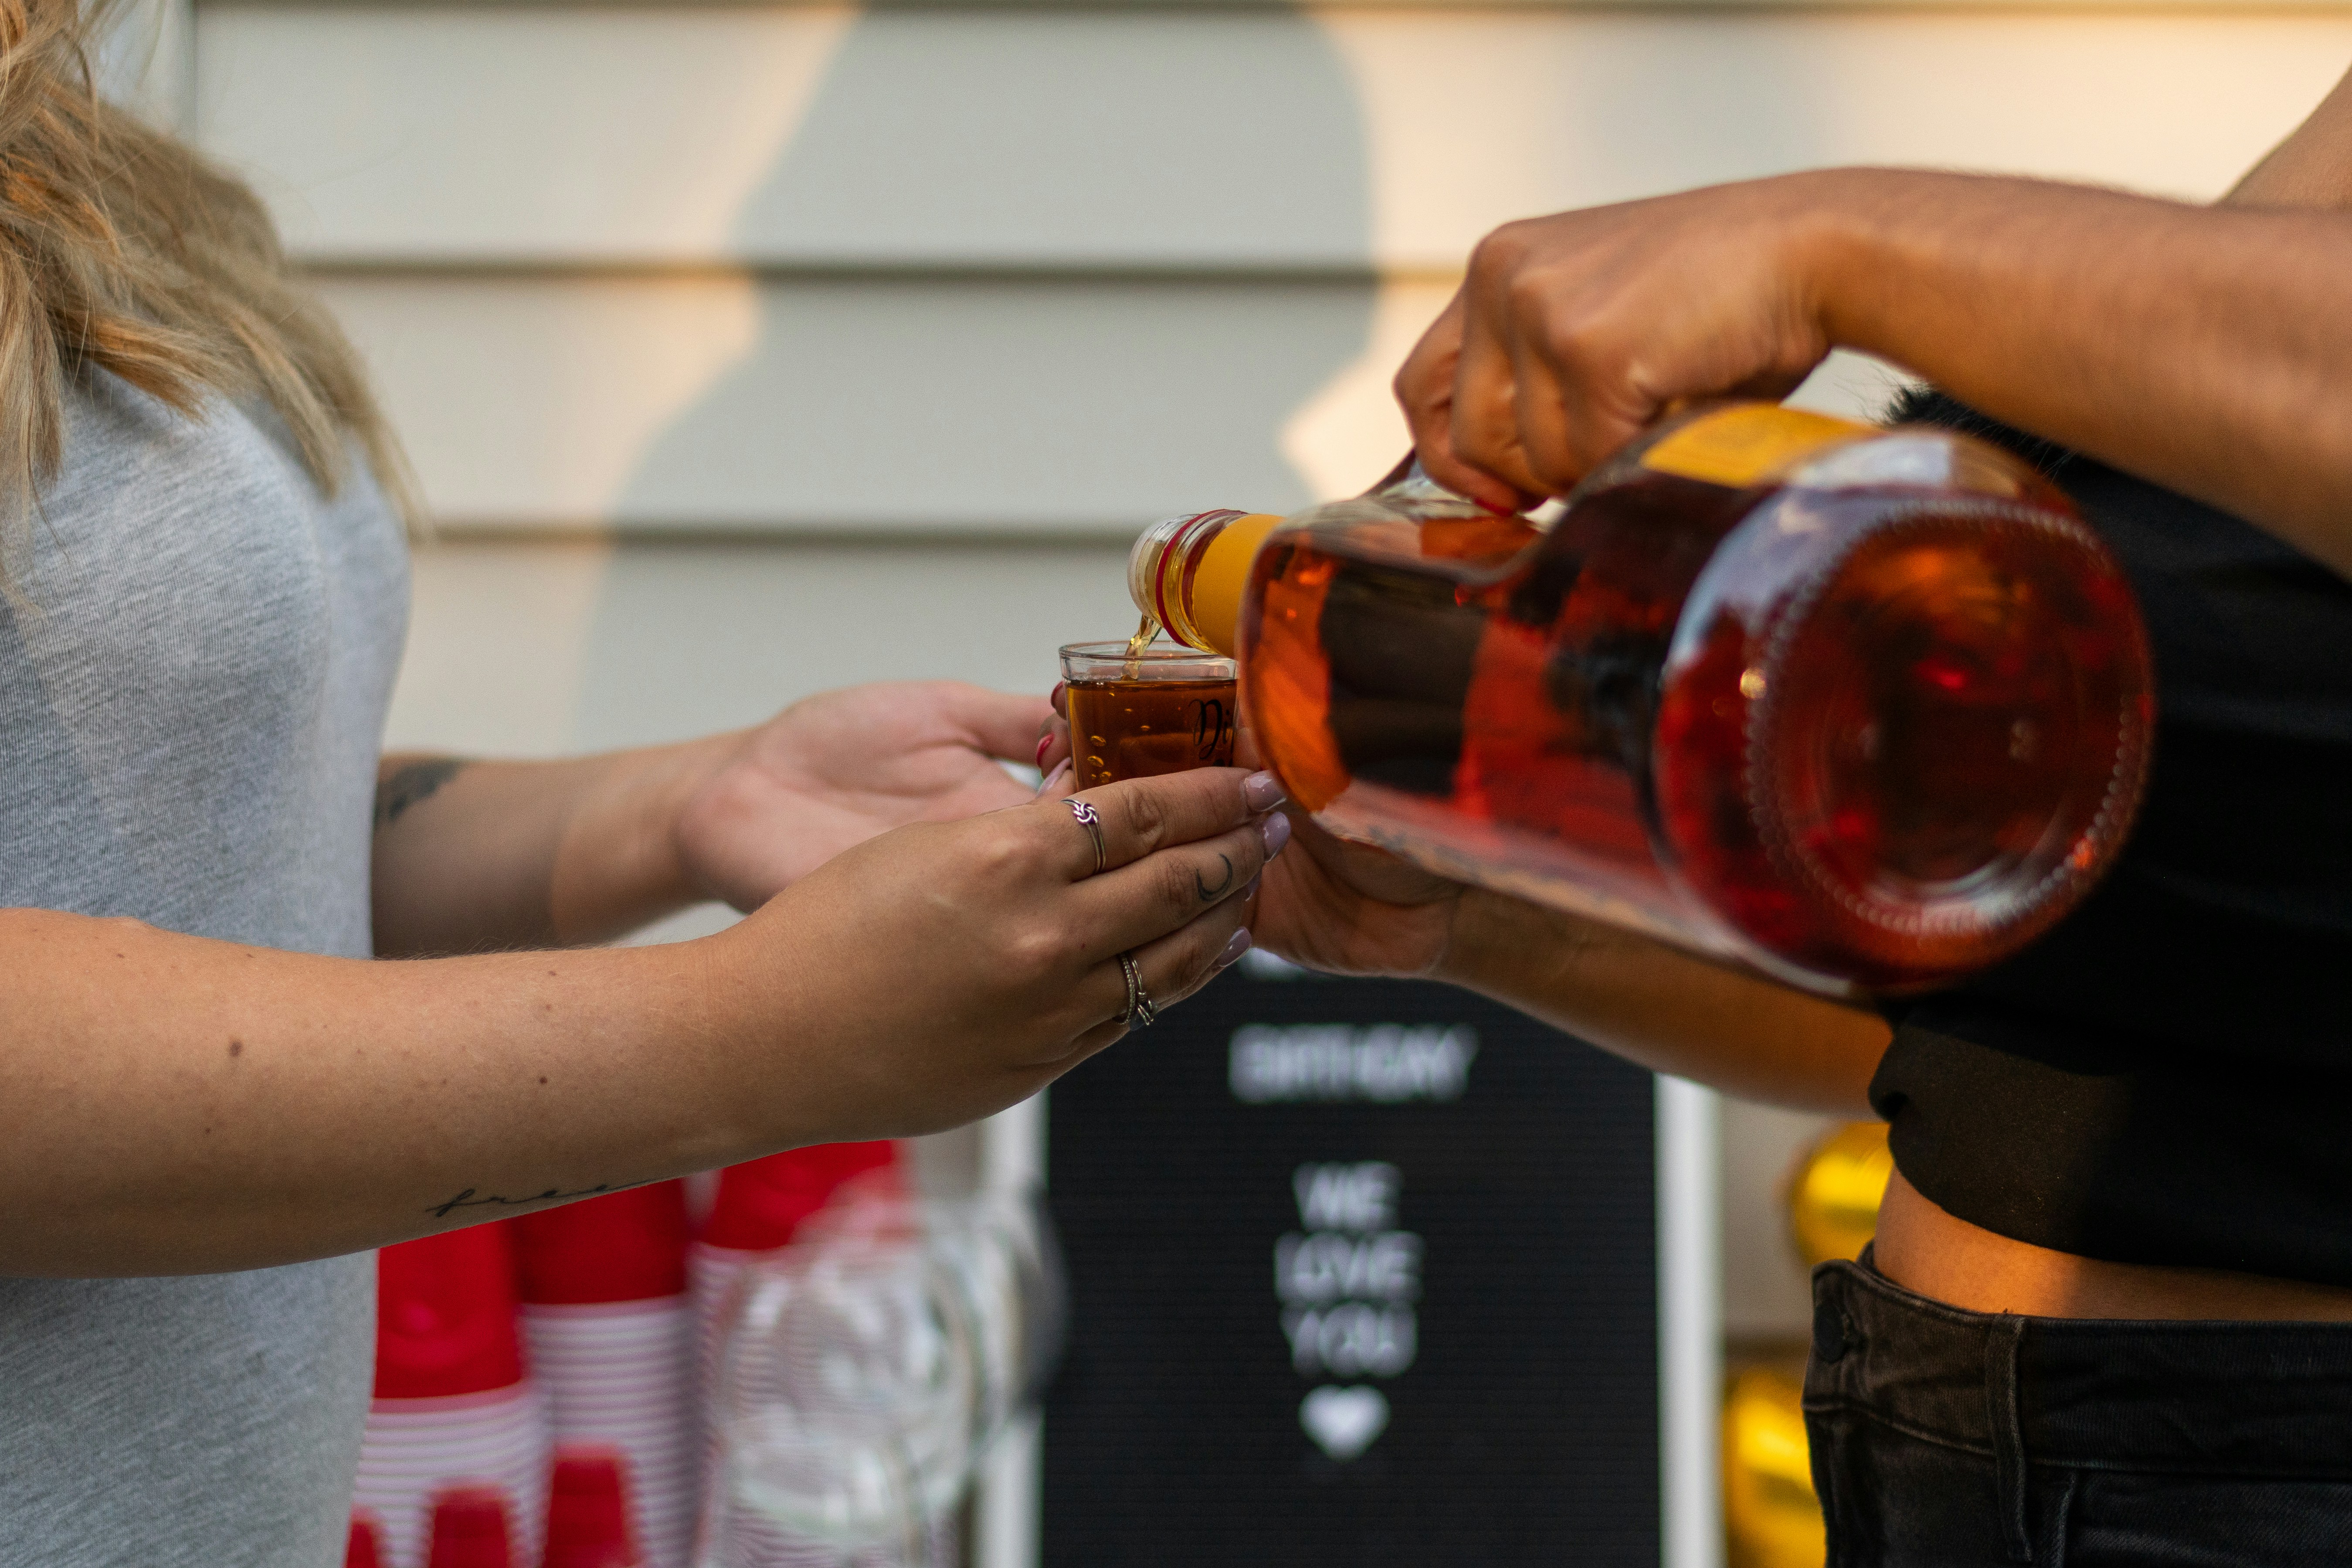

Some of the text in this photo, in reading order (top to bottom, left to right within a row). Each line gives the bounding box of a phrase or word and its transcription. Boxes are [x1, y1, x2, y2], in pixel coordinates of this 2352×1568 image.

[1228, 1024, 1476, 1103] BIRTHDAY
[1292, 1161, 1398, 1229] WE
[1273, 1231, 1422, 1301] LOVE
[1280, 1302, 1417, 1377] YOU
